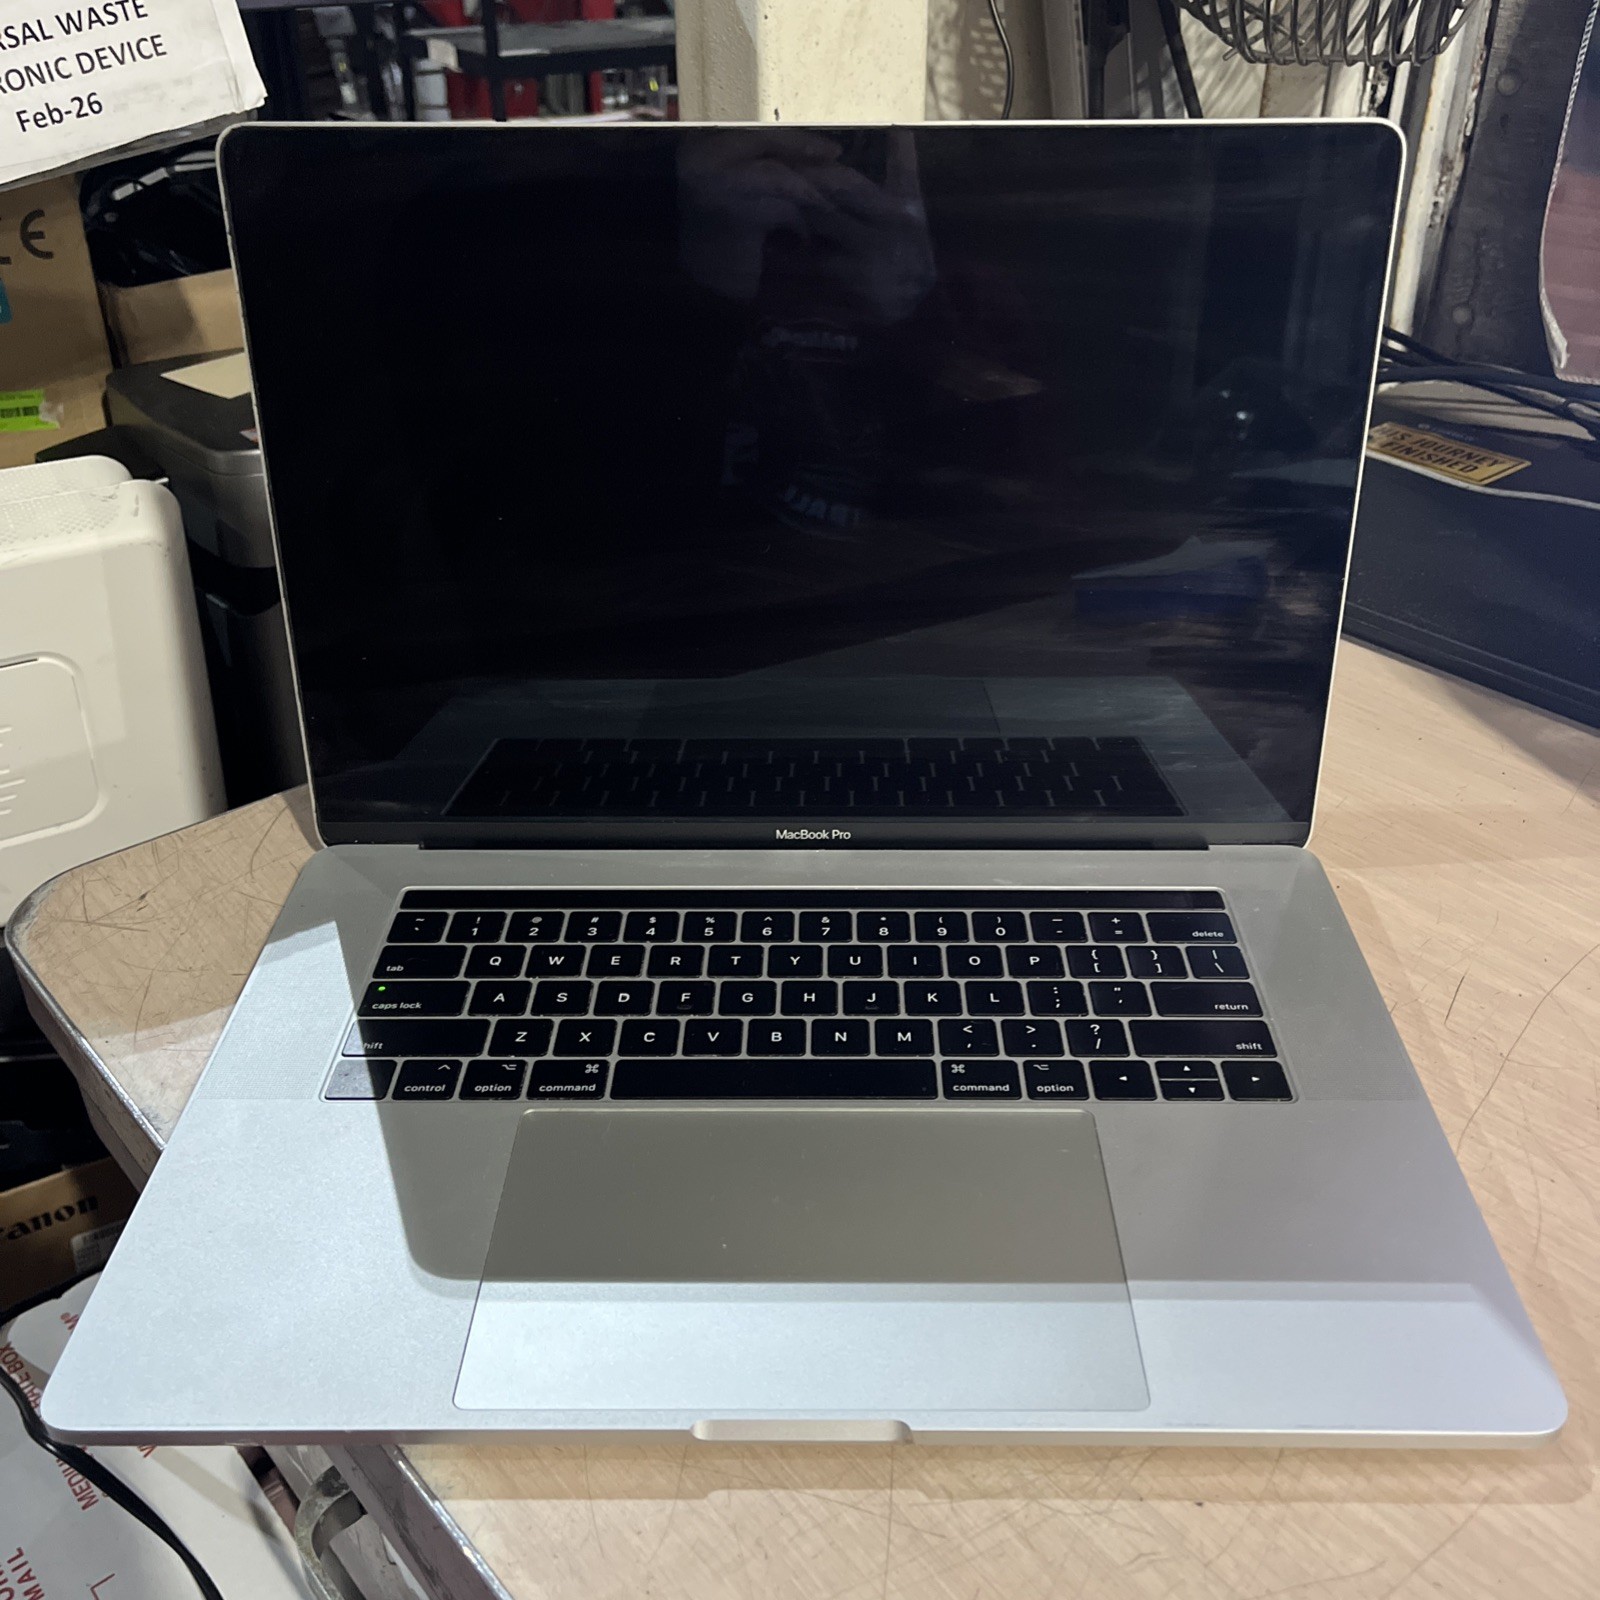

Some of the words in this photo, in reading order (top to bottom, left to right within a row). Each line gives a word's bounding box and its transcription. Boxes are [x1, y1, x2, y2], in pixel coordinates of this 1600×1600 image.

[55, 0, 149, 36] WASTE
[75, 34, 168, 75] DEVICE
[15, 92, 104, 133] Feb-26
[1380, 440, 1479, 473] FINISHED
[1411, 437, 1503, 468] JOURNEY
[775, 829, 829, 840] MacBook
[831, 829, 852, 840] Pro
[528, 927, 539, 936] 2
[587, 927, 598, 936] 3
[645, 927, 656, 936] 4
[704, 927, 714, 937] 5
[762, 927, 773, 936] 6
[821, 927, 831, 936] 7
[878, 926, 889, 936] 8
[936, 927, 948, 937] 9
[1191, 930, 1224, 938] delete
[489, 956, 502, 966] Q
[548, 956, 565, 966] W
[610, 955, 621, 966] E
[670, 956, 682, 966] R
[730, 956, 742, 966] T
[790, 956, 801, 966] Y
[849, 956, 861, 966] U
[1029, 956, 1040, 966] P
[493, 992, 505, 1003] A
[556, 992, 568, 1003] S
[618, 992, 630, 1003] D
[680, 992, 691, 1003] F
[741, 992, 754, 1003] G
[803, 992, 816, 1003] H
[866, 992, 876, 1003] J
[927, 992, 938, 1003] K
[989, 992, 1000, 1003] L
[371, 1003, 398, 1011] caps
[1214, 1003, 1249, 1011] return
[515, 1031, 528, 1042] Z
[579, 1031, 592, 1042] X
[643, 1031, 656, 1043] C
[707, 1031, 720, 1042] V
[771, 1031, 783, 1042] B
[834, 1031, 847, 1042] N
[897, 1031, 912, 1042] M
[1235, 1042, 1263, 1050] shift
[404, 1084, 446, 1092] control
[474, 1083, 512, 1093] option
[538, 1083, 597, 1092] command
[952, 1084, 1010, 1092] command
[1036, 1084, 1074, 1093] option
[0, 1195, 98, 1241] anon
[7, 1546, 45, 1600] MAIL
